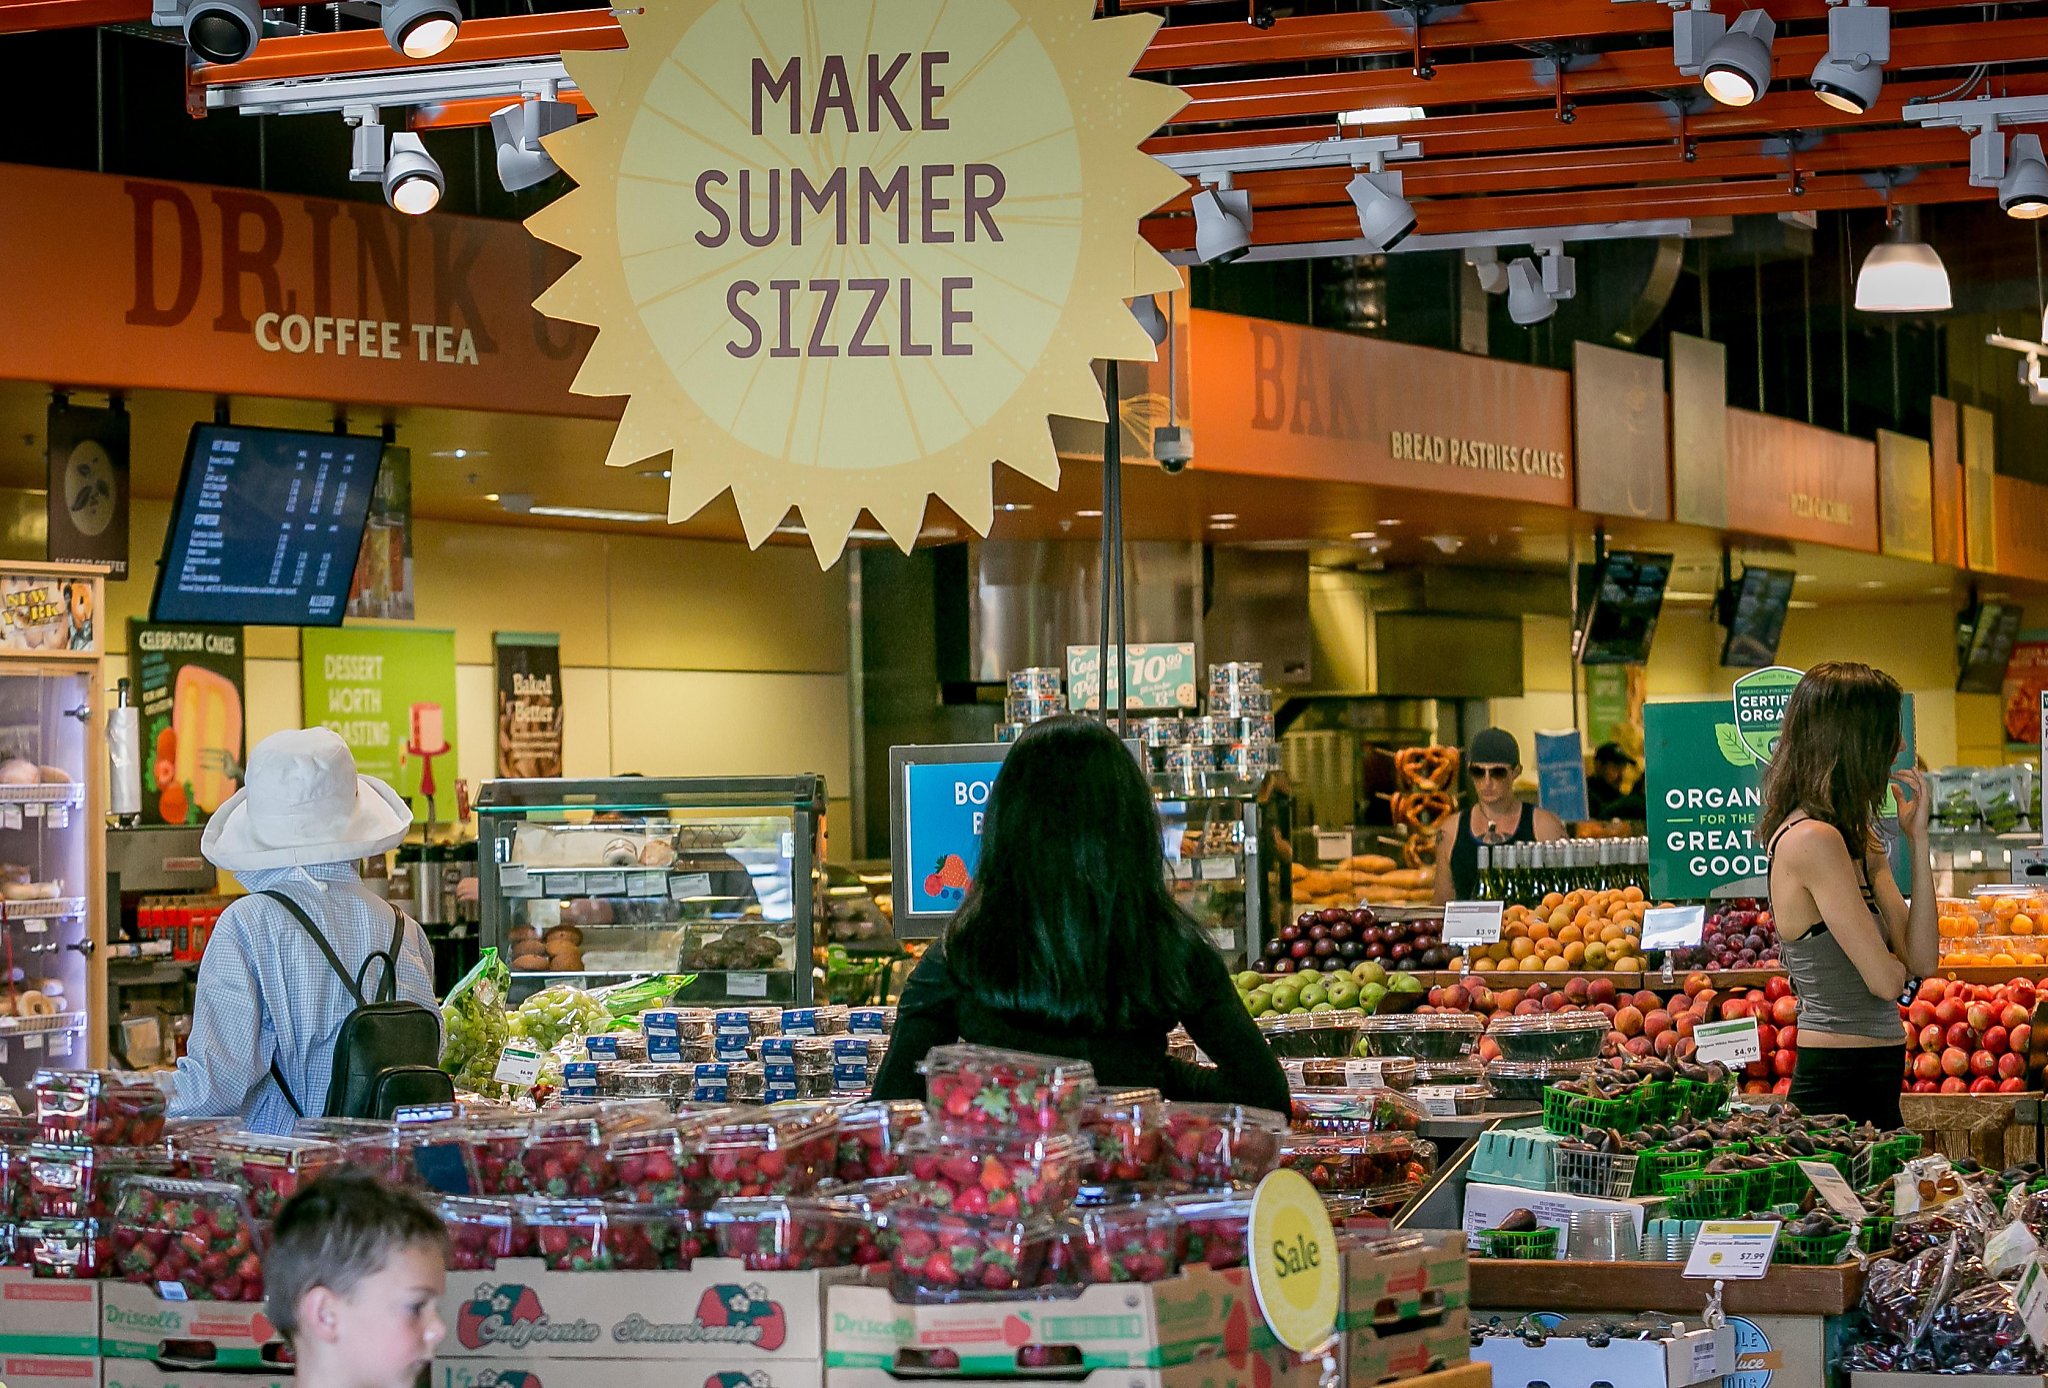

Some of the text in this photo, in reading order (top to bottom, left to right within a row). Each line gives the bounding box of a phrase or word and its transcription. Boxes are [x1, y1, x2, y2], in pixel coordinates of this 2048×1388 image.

[751, 51, 950, 136] MAKE
[694, 163, 1007, 249] SUMMER
[124, 181, 499, 354] DRINK
[726, 277, 974, 359] SIZZLE
[255, 312, 479, 366] COFFEE TEA
[1392, 431, 1565, 480] BREAD PASTRIES CAKES
[139, 631, 236, 655] CELEBRATION CAKES
[325, 654, 384, 680] DESSERT
[513, 673, 553, 695] Baked
[328, 687, 383, 713] WORTH
[515, 700, 555, 722] Better
[1740, 695, 1792, 707] CERTIF
[1740, 708, 1785, 722] ORGA
[1665, 786, 1761, 810] ORGAN
[1700, 813, 1756, 826] FOR THE
[1666, 829, 1764, 852] GREAT
[1689, 855, 1769, 877] GOOD
[1698, 1028, 1720, 1037] Organic
[1734, 1046, 1757, 1056] $4.99
[1273, 1233, 1320, 1278] Sale
[1740, 1252, 1765, 1261] $7.99
[479, 1314, 600, 1349] California
